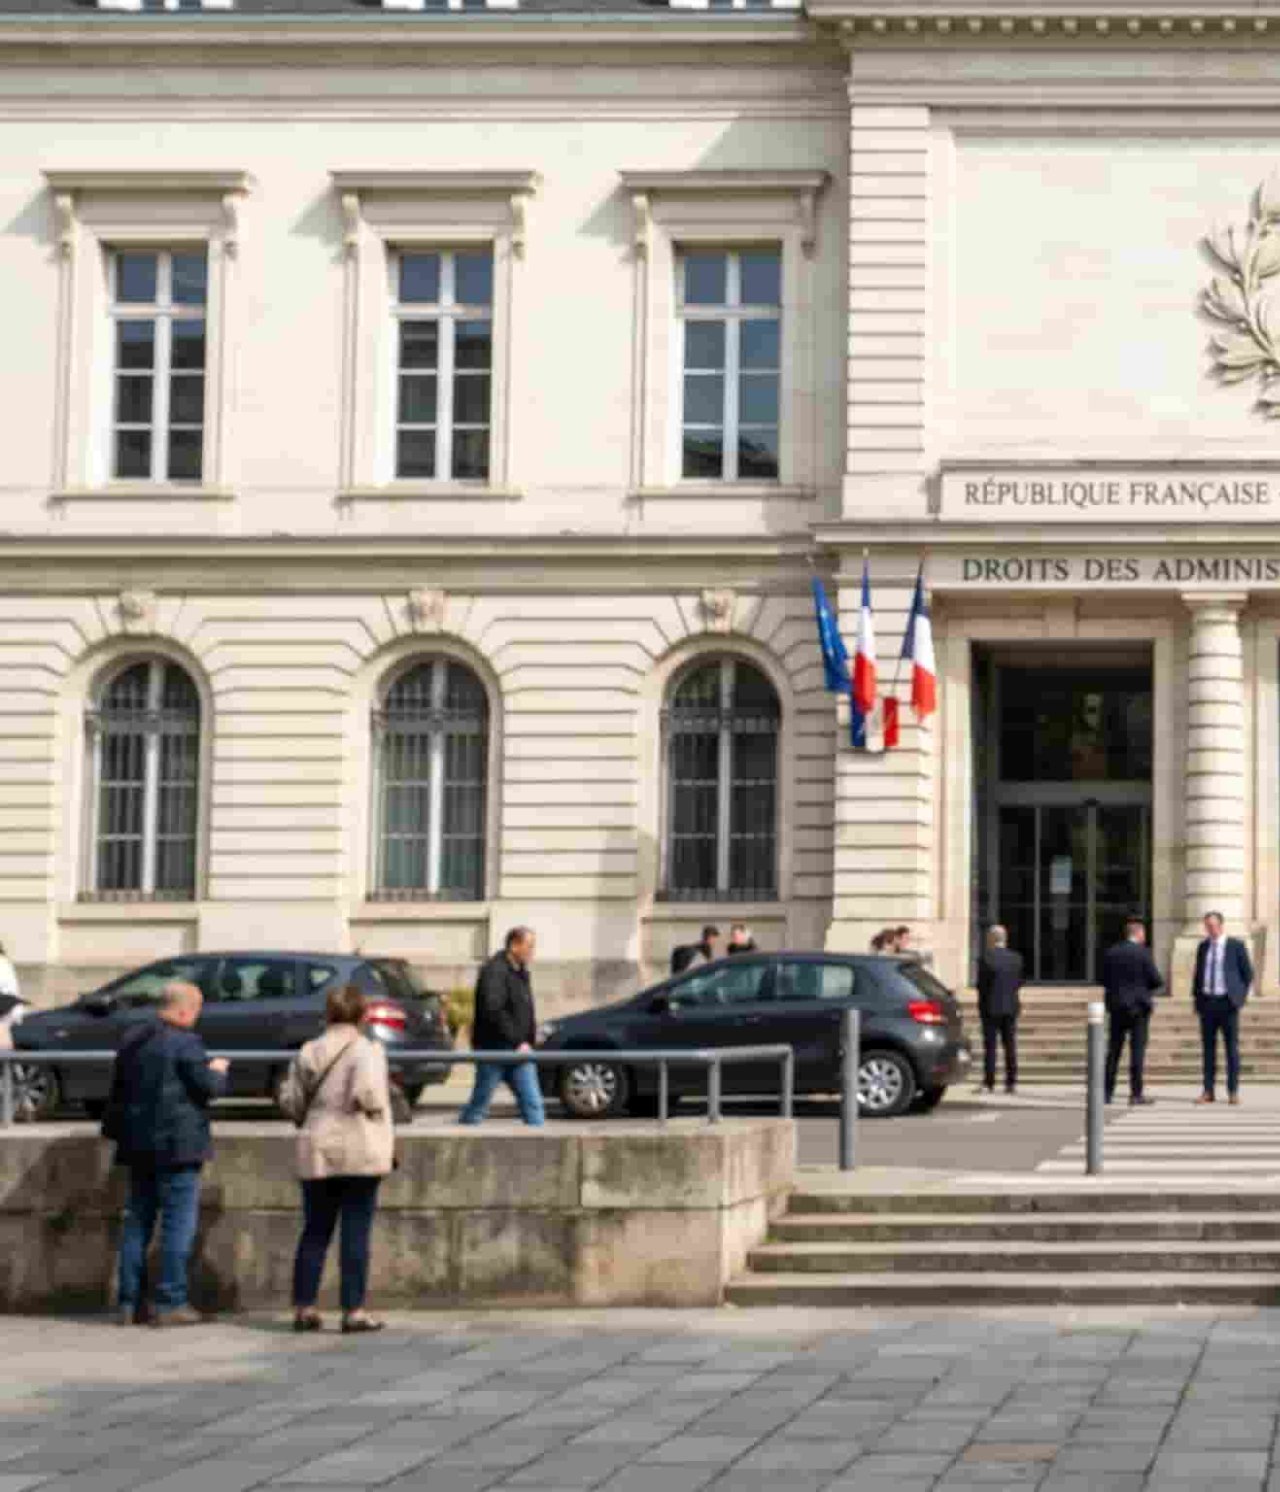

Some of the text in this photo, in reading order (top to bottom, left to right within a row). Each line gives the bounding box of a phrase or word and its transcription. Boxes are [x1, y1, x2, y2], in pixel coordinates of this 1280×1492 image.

[964, 478, 1120, 509] RÉPUBLIQUE
[1129, 481, 1269, 509] FRANÇAISE
[962, 558, 1069, 582] DROITS
[1083, 558, 1140, 582] DES
